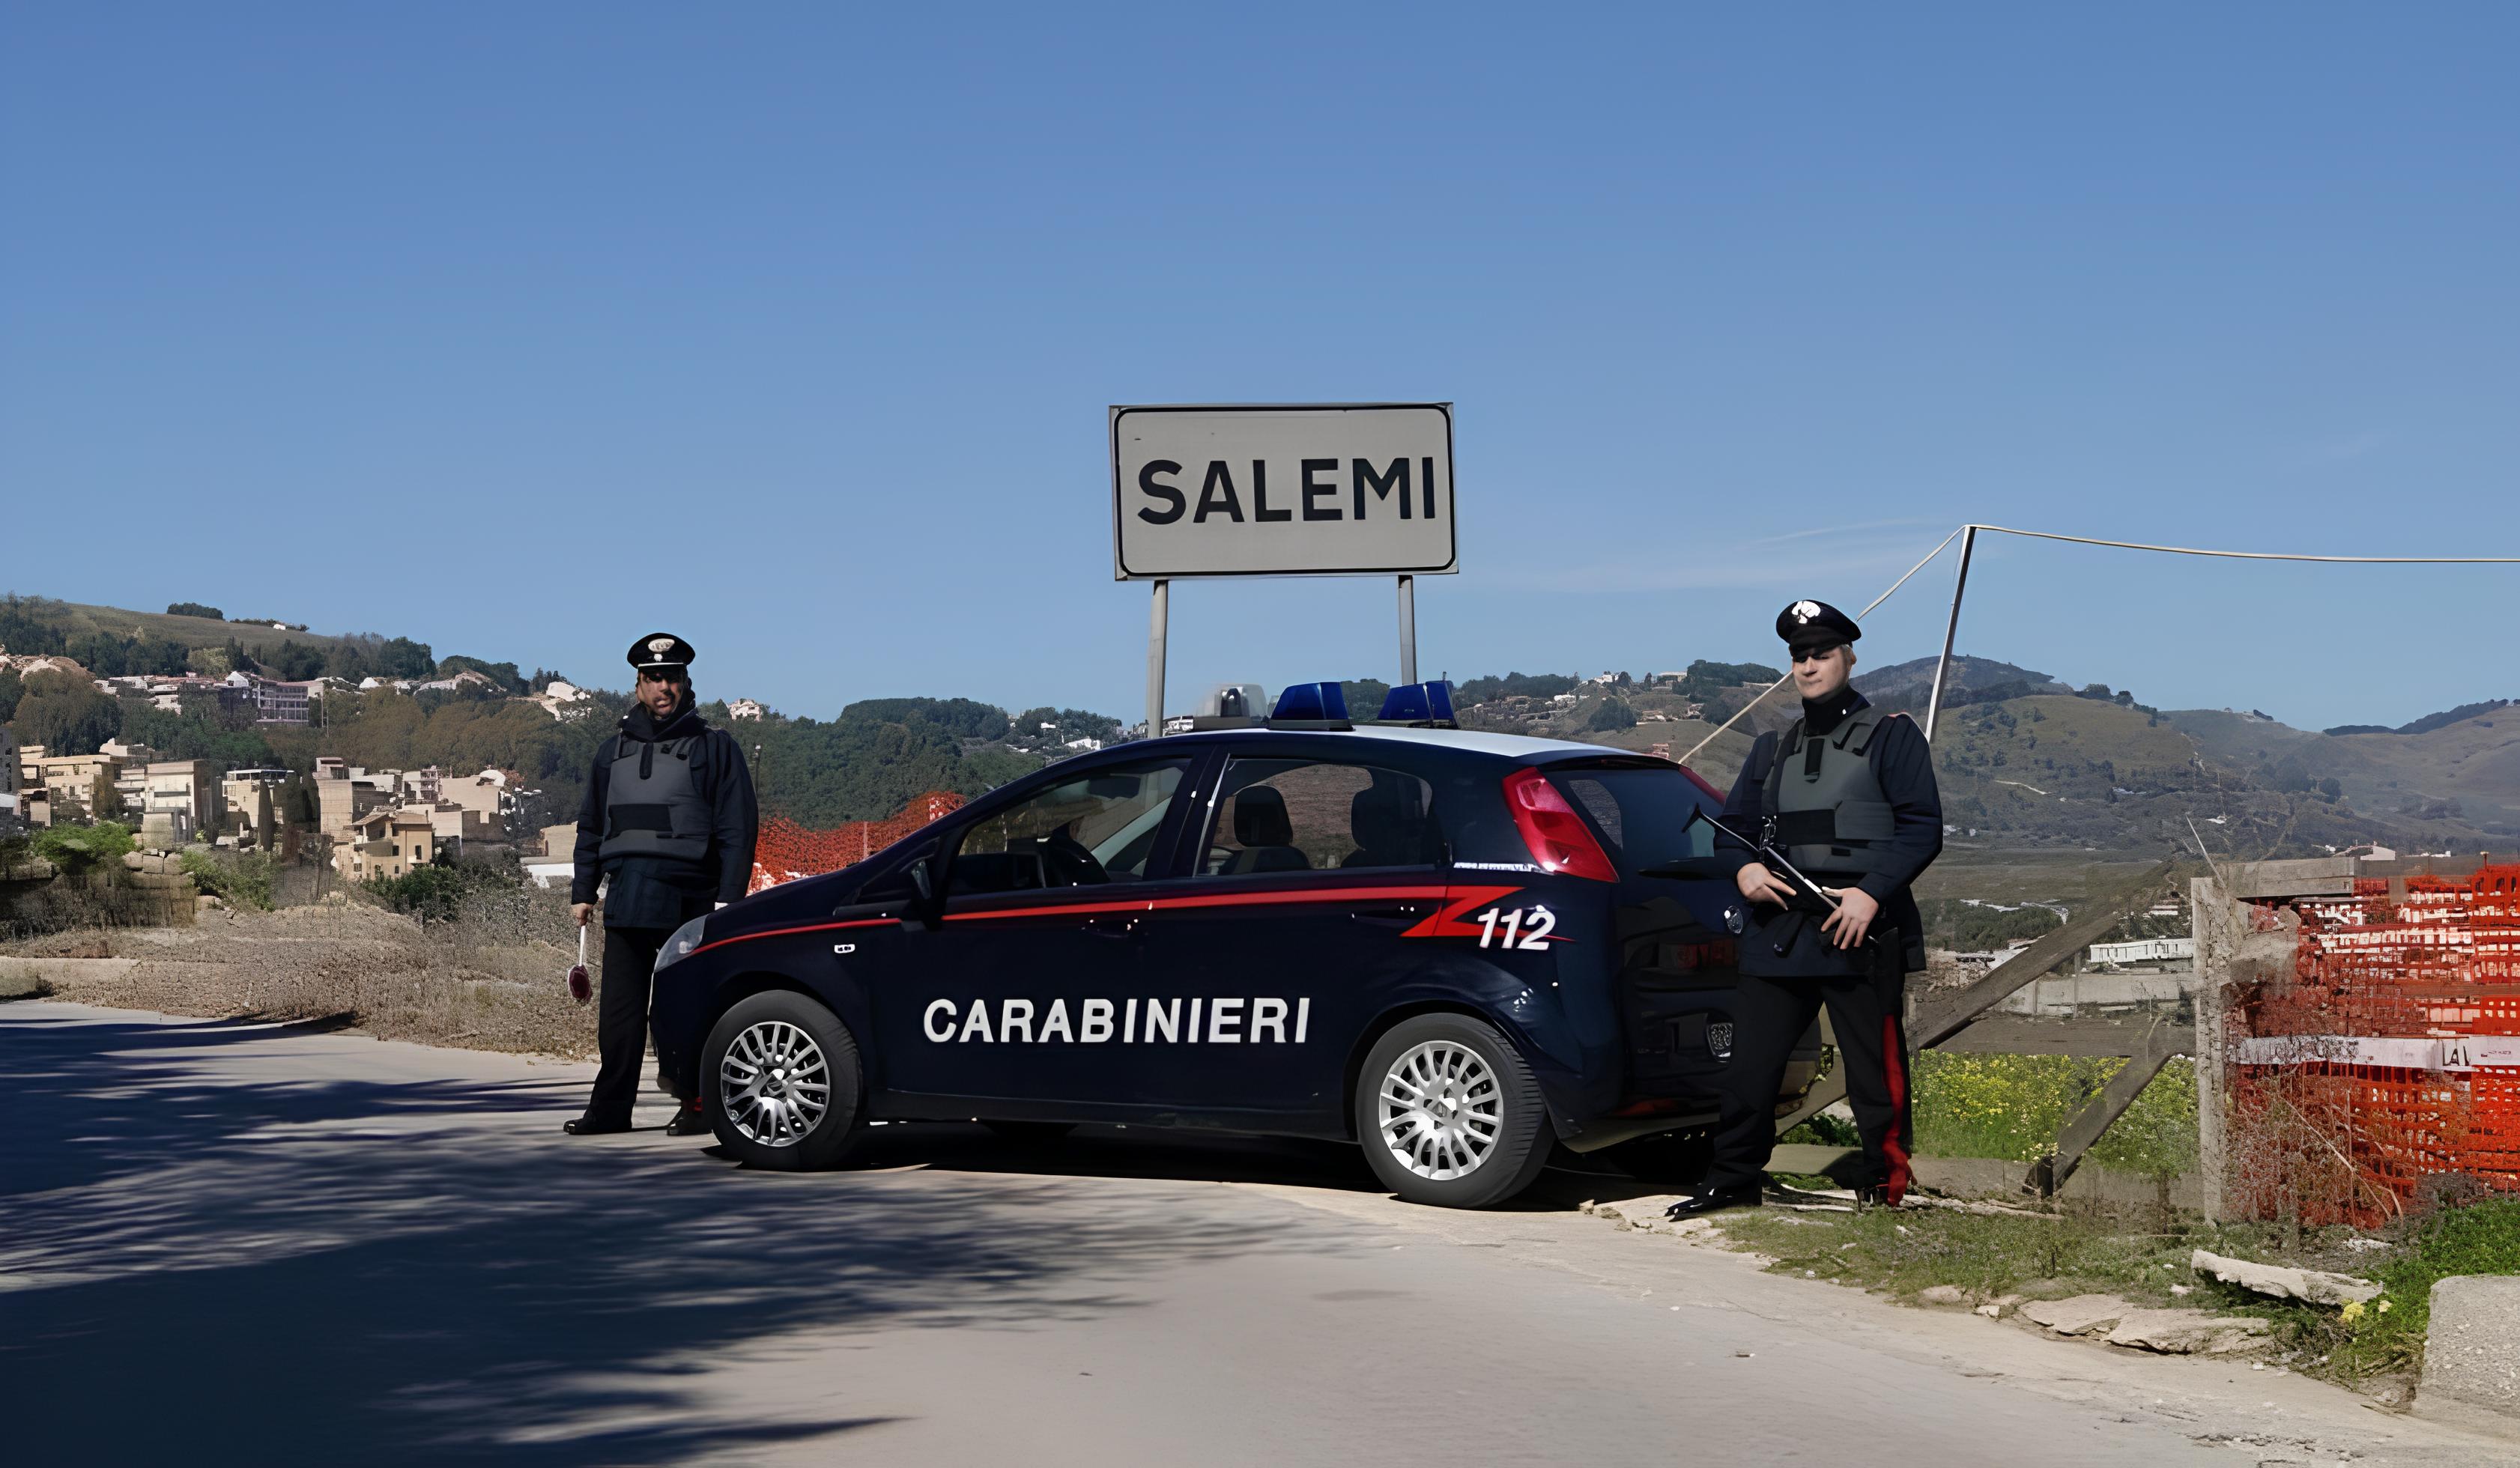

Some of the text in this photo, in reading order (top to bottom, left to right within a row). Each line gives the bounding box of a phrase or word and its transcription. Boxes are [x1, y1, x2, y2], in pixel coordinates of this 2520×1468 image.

[1137, 456, 1436, 525] SALEMI
[1476, 905, 1556, 950] 112
[923, 998, 1310, 1043] CARABINIERI
